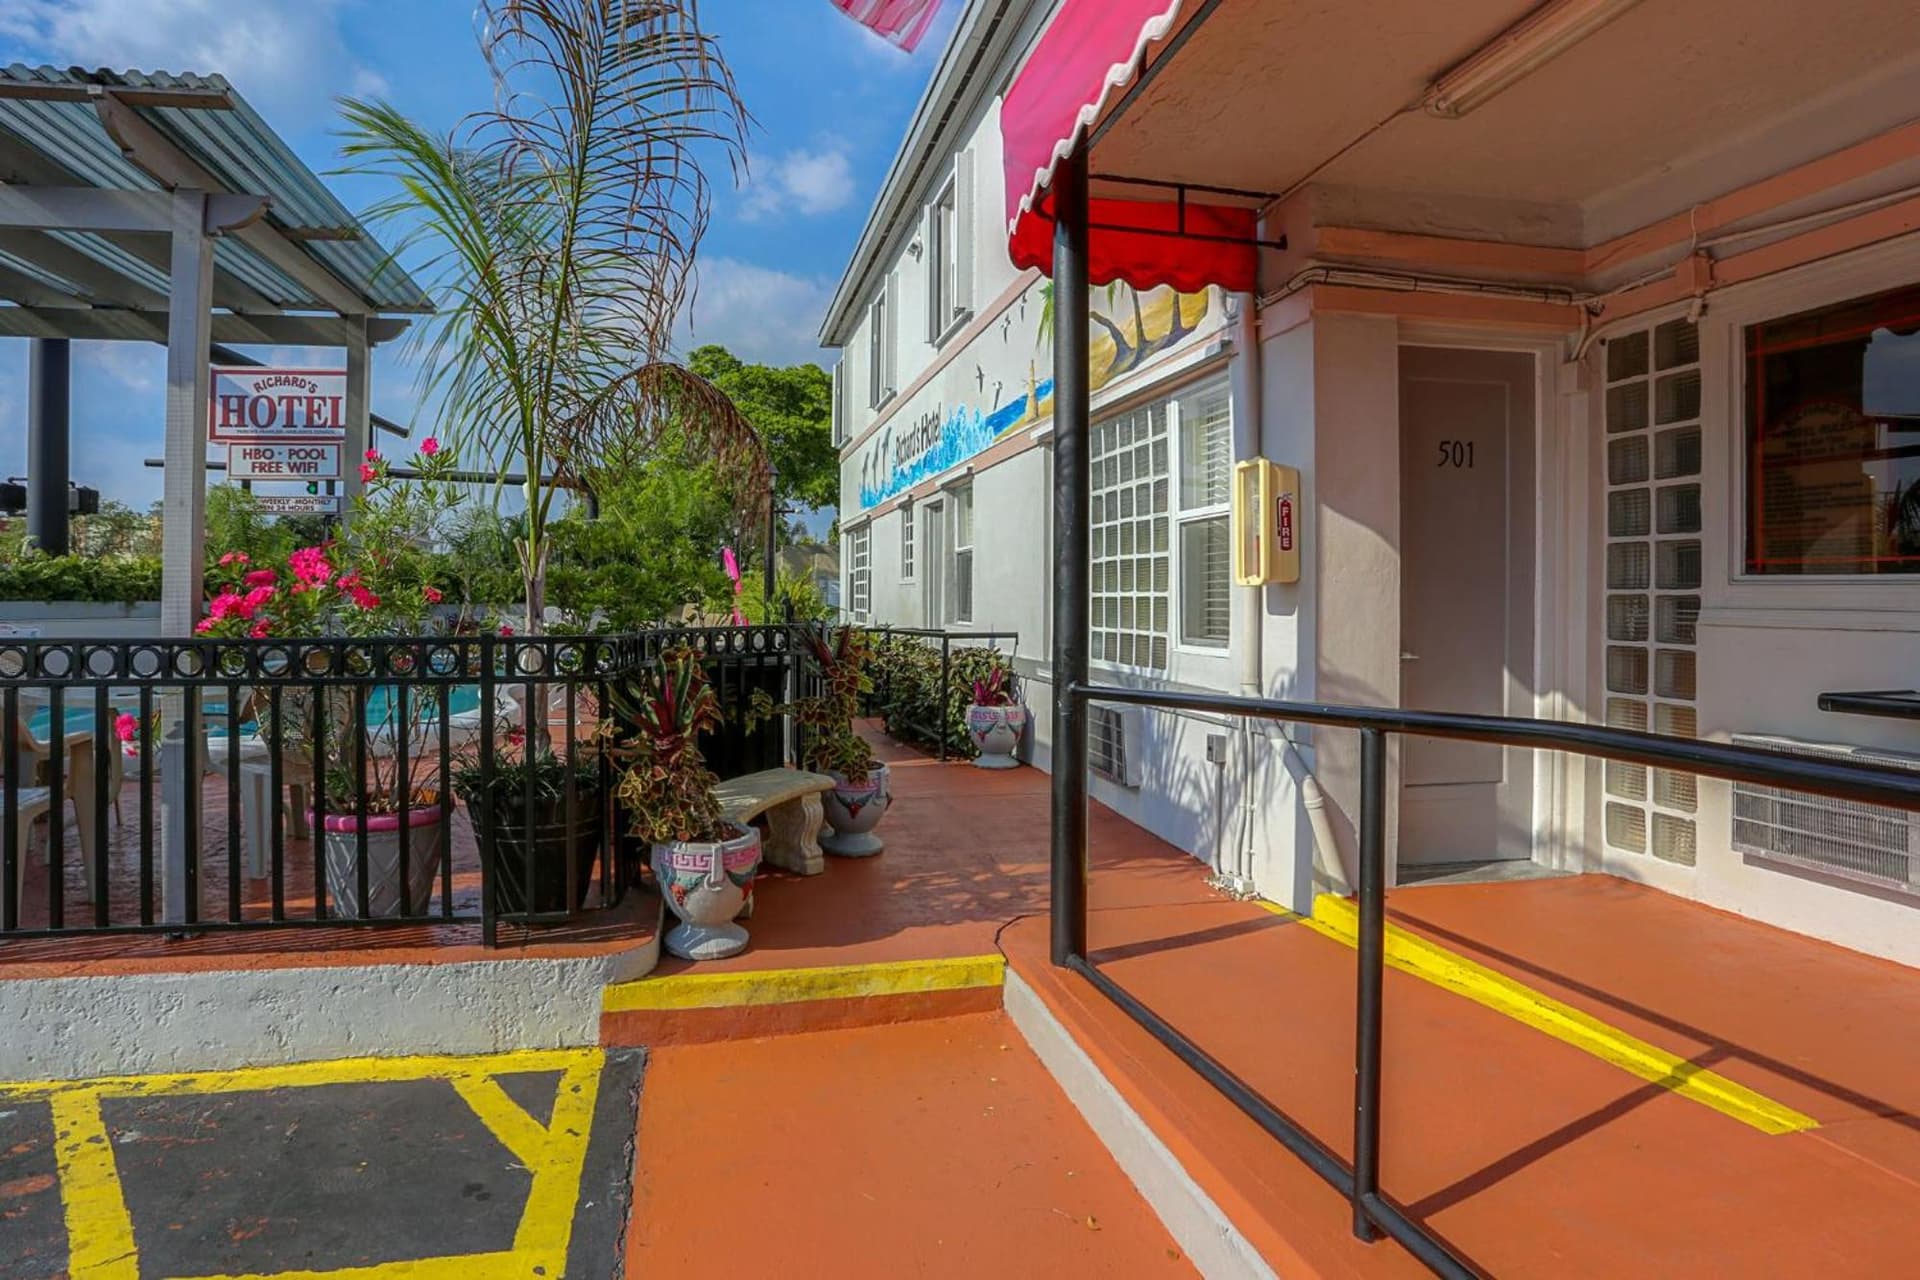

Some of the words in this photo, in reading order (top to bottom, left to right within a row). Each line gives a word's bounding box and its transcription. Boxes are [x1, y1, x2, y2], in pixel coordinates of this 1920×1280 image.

[253, 375, 318, 394] RICHARD'S
[920, 402, 941, 452] Hotel
[242, 448, 275, 460] HBO
[287, 448, 328, 460] POOL
[1437, 440, 1474, 468] 501
[251, 462, 283, 473] FREE
[287, 462, 318, 473] WIFI
[1282, 507, 1290, 548] FIRE
